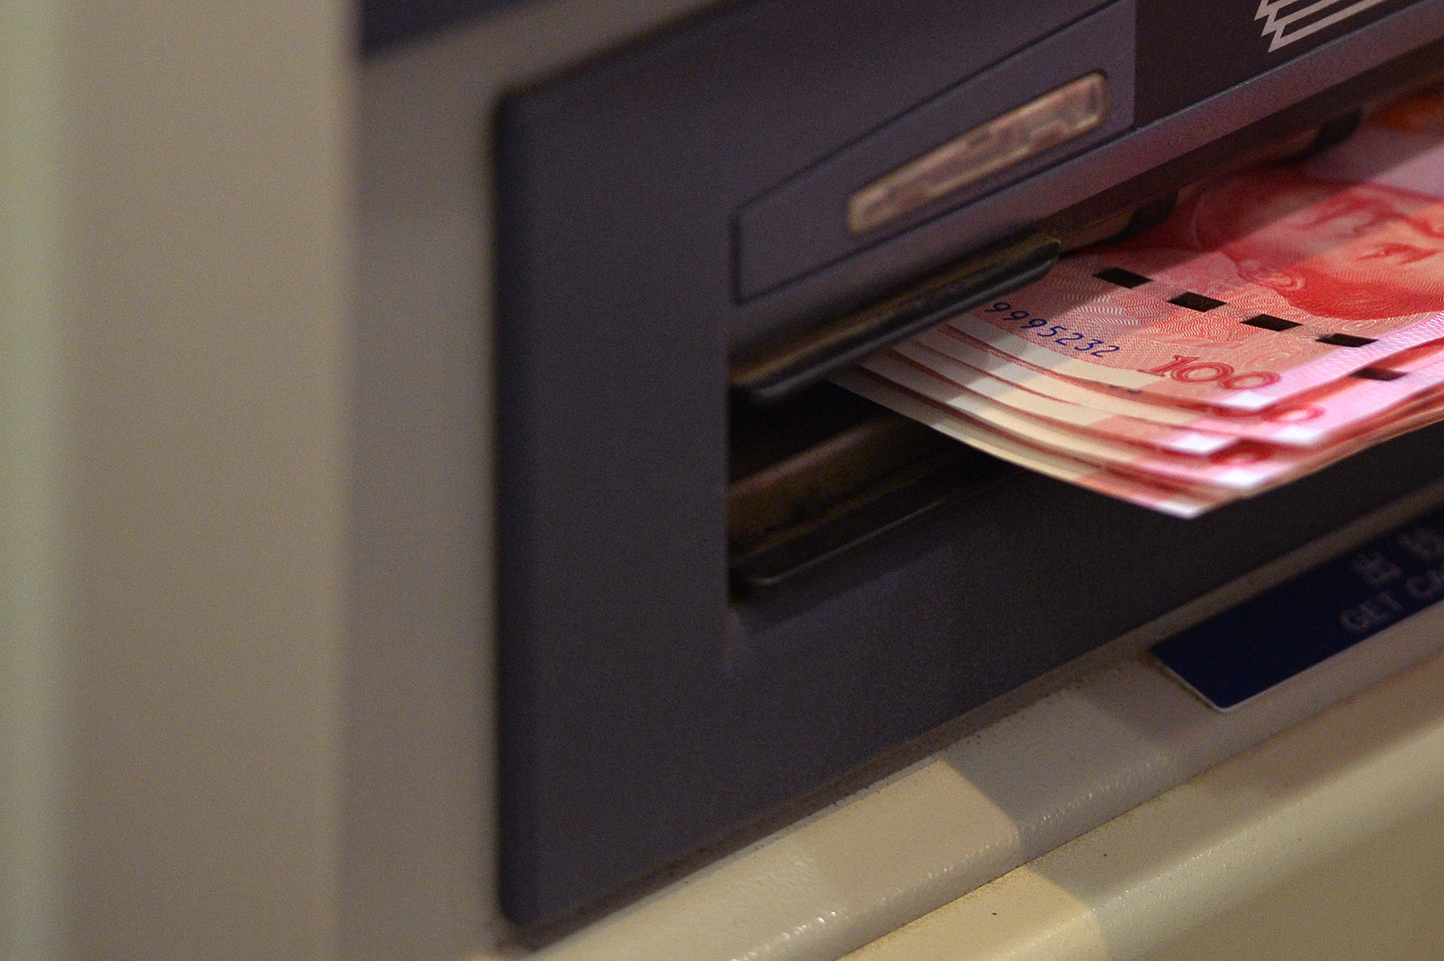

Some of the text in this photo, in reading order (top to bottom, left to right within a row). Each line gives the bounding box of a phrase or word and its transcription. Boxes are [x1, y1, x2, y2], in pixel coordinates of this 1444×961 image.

[984, 301, 1120, 357] 9995232
[1138, 354, 1282, 390] 100
[1339, 590, 1404, 633] GET
